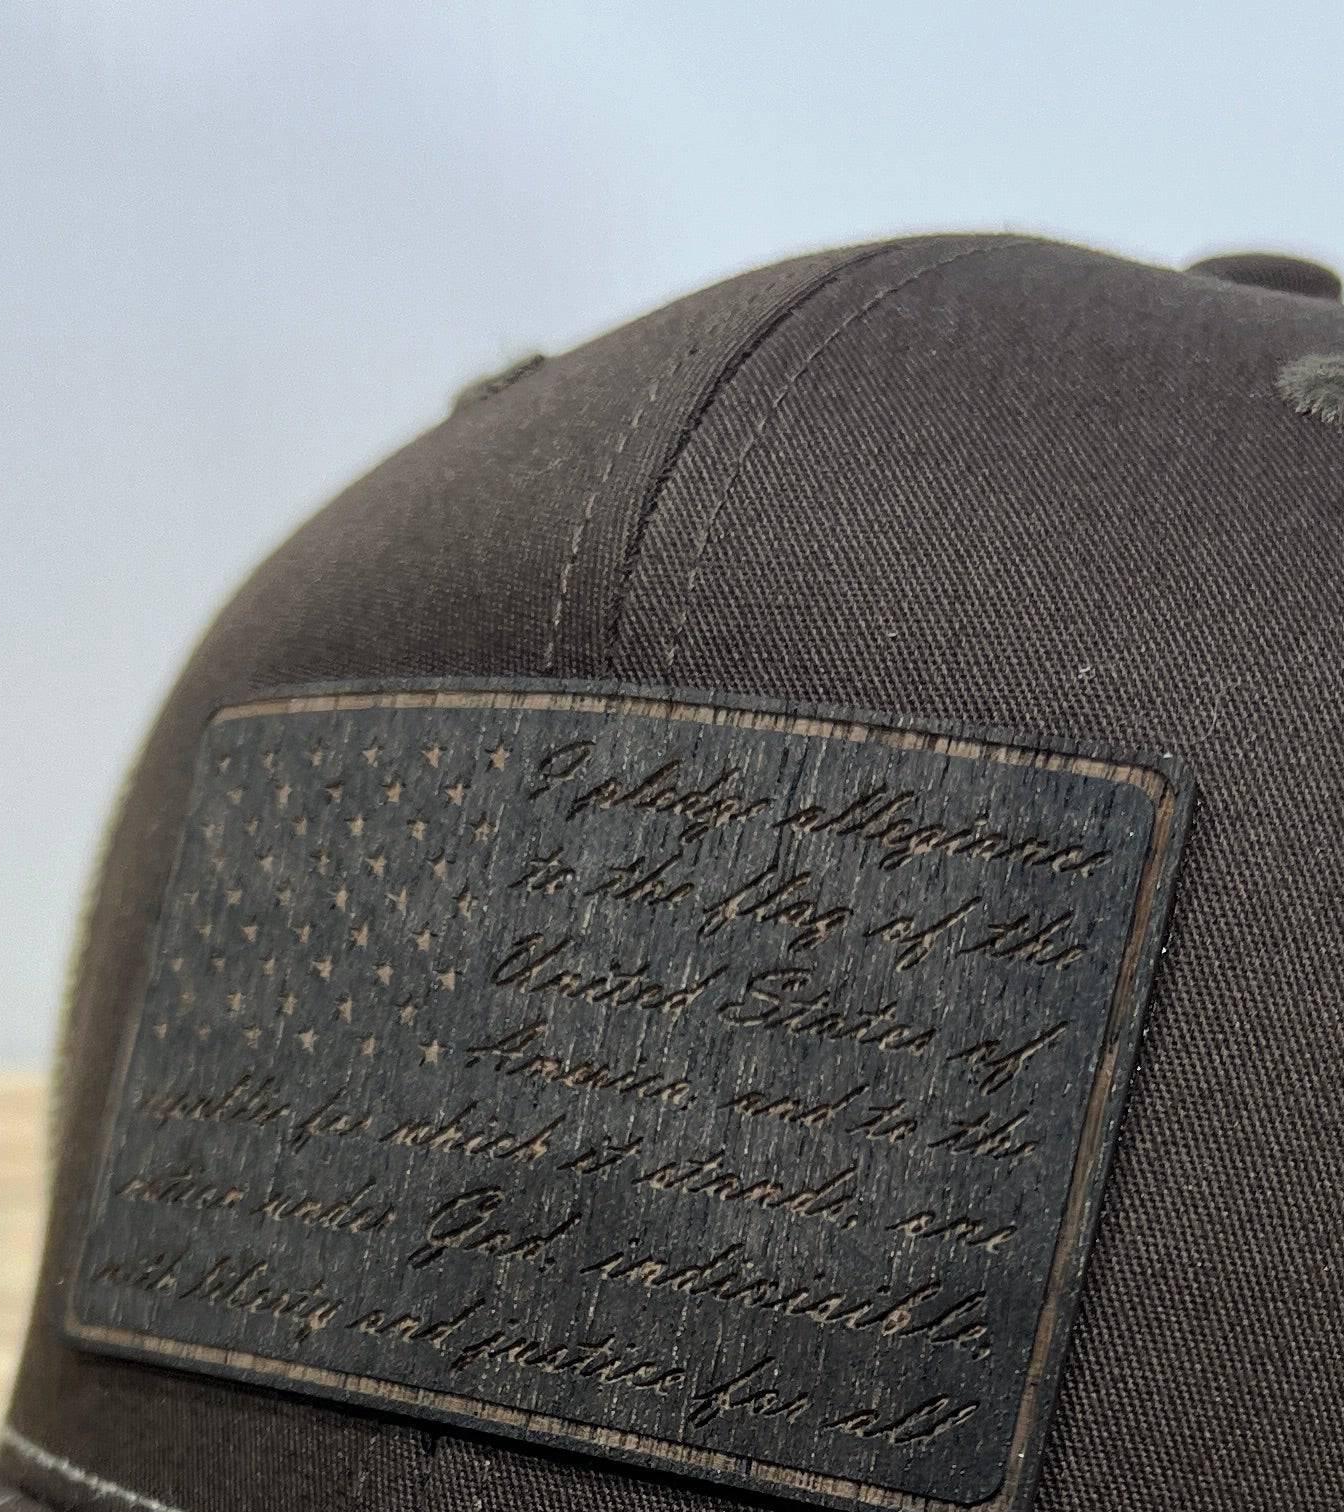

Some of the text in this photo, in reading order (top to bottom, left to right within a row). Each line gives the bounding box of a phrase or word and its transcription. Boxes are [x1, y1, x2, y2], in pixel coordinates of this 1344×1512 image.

[566, 760, 771, 844] pledge
[773, 785, 1113, 877] allegiance
[508, 849, 1088, 972] to the flag of the
[491, 932, 1068, 1096] United States of
[379, 1100, 566, 1162] which
[557, 1136, 644, 1177] it
[886, 1211, 1018, 1253] one
[718, 1083, 869, 1130] and
[846, 1101, 919, 1143] to
[928, 1110, 1040, 1162] the
[249, 1176, 398, 1233] under
[178, 1254, 346, 1344] liberty
[346, 1298, 486, 1350] and
[452, 1318, 686, 1395] justice
[686, 1355, 811, 1430] for
[823, 1394, 981, 1445] all
